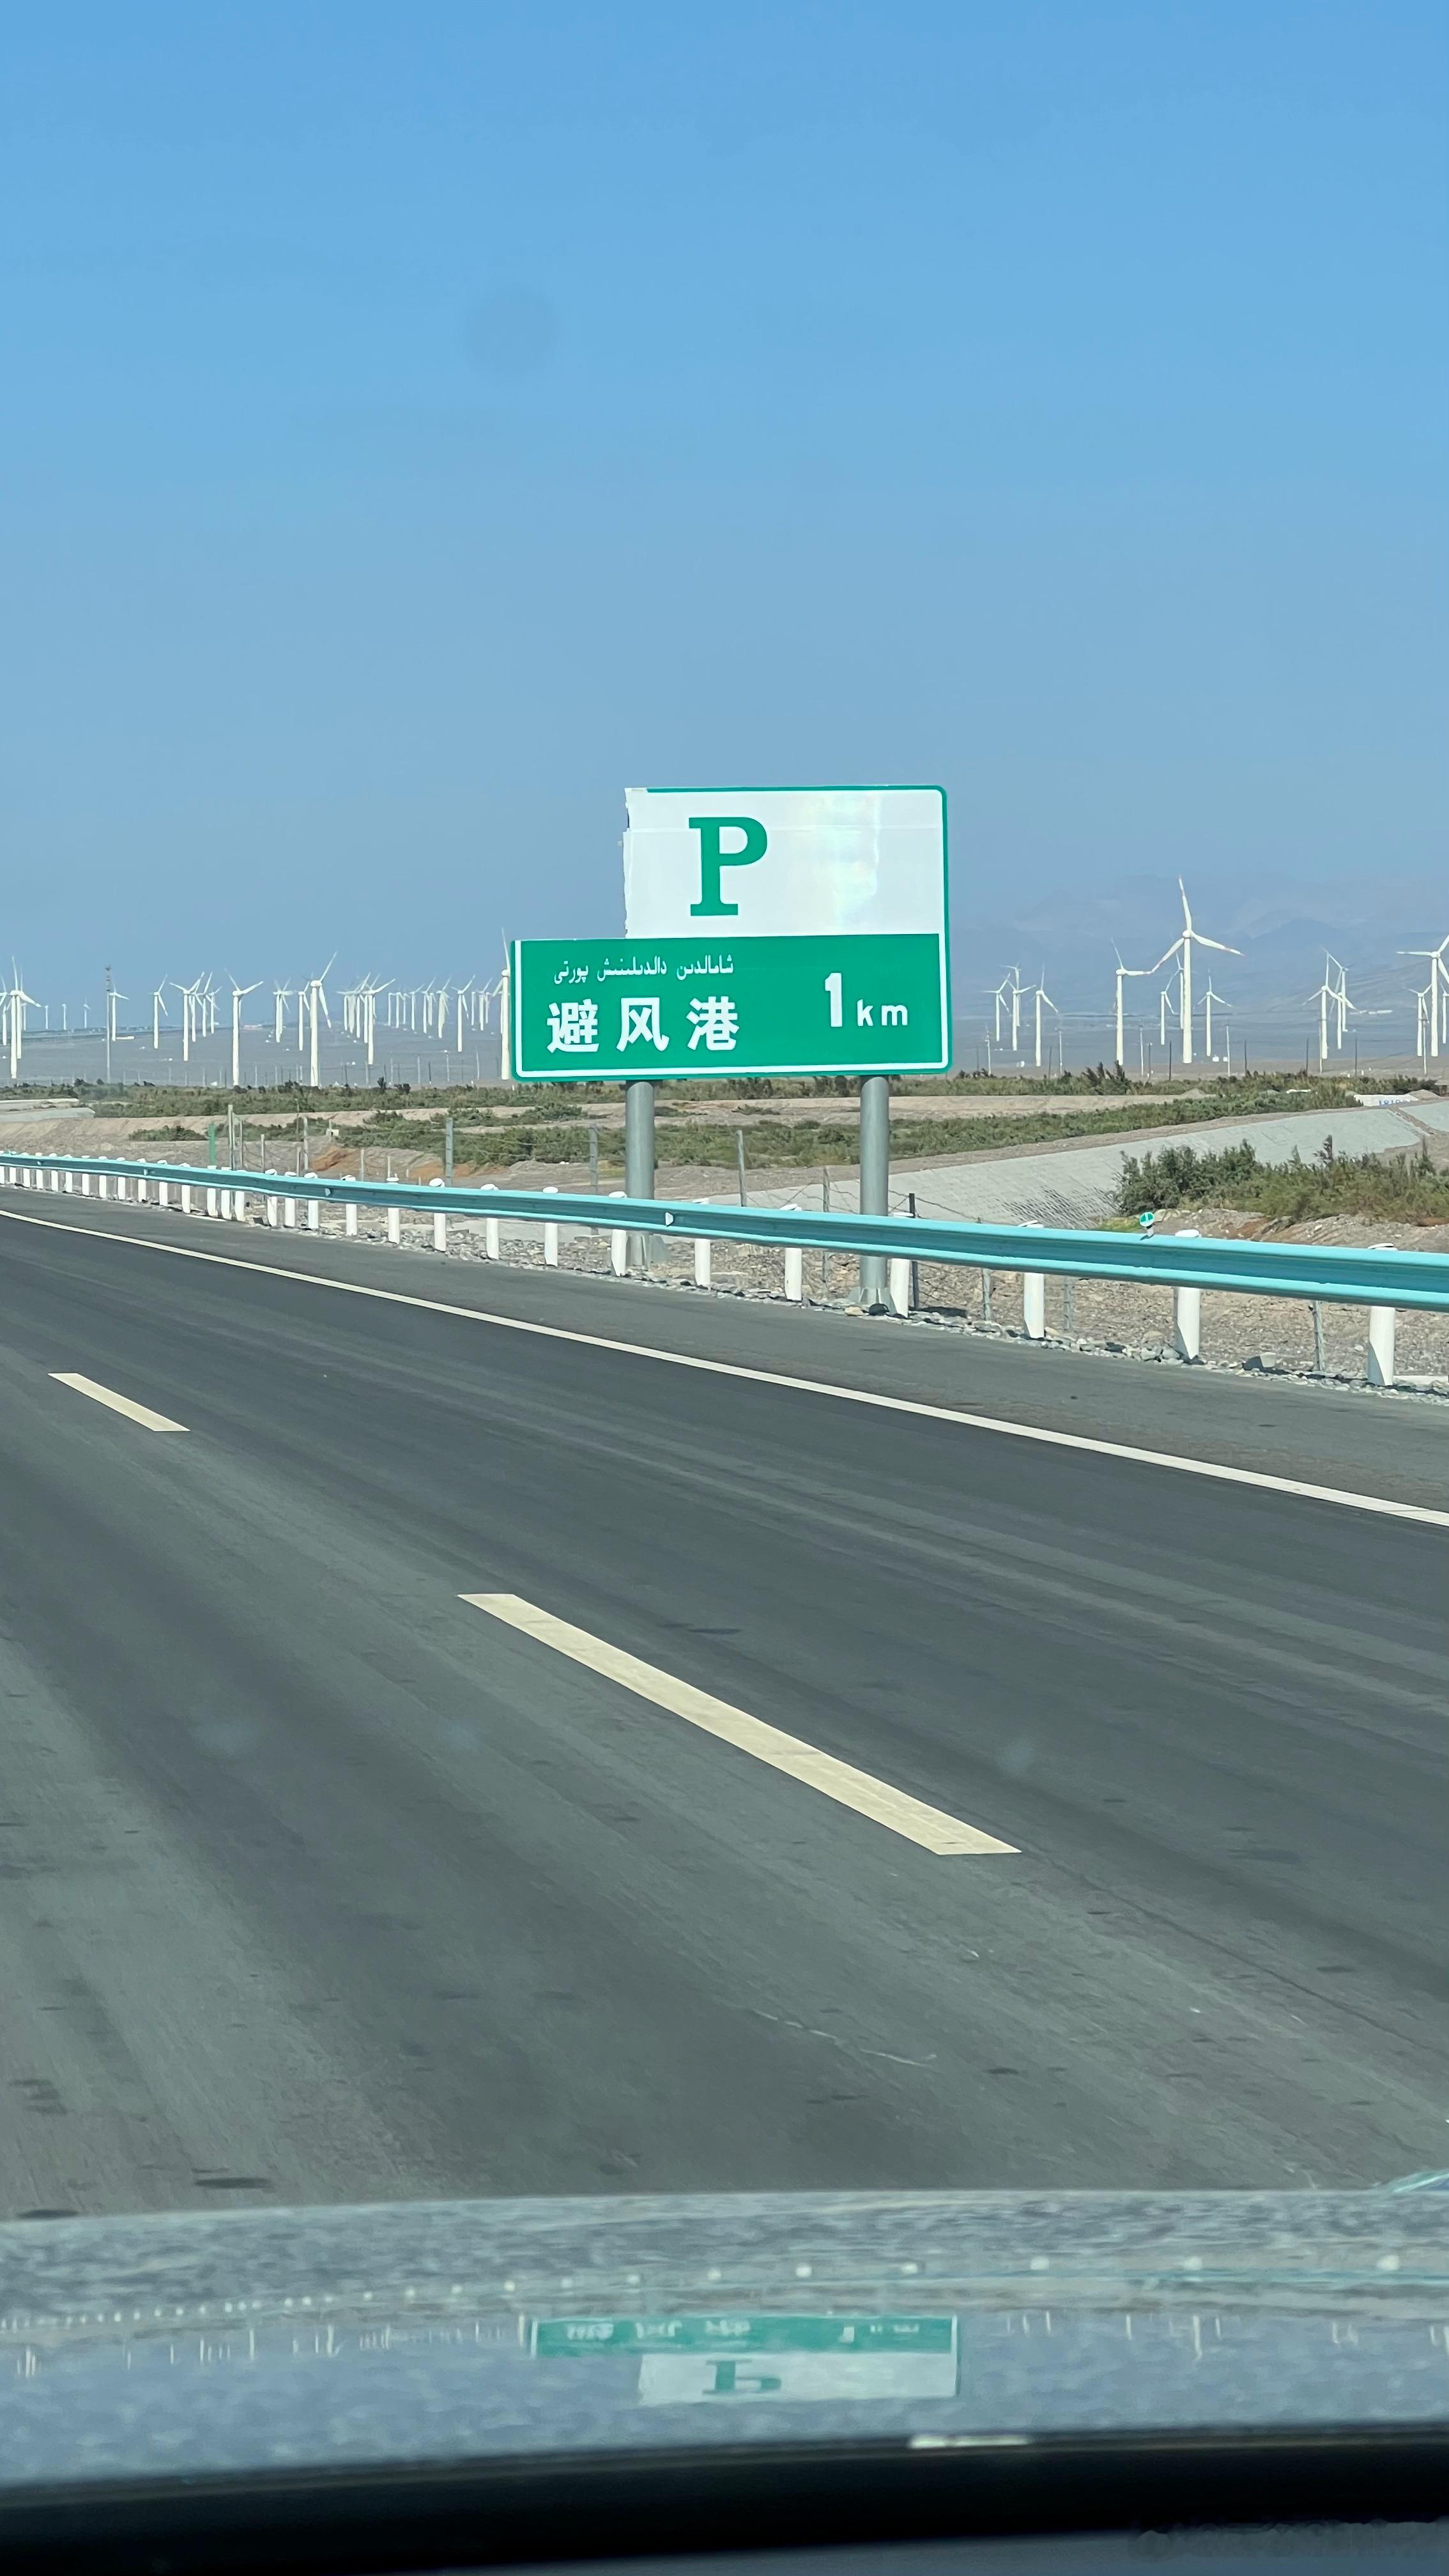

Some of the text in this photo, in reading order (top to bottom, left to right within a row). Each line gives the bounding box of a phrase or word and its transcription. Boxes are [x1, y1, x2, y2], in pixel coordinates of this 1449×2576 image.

[689, 817, 767, 916] P
[547, 996, 739, 1053] 避风港
[825, 972, 908, 1027] 1 km
